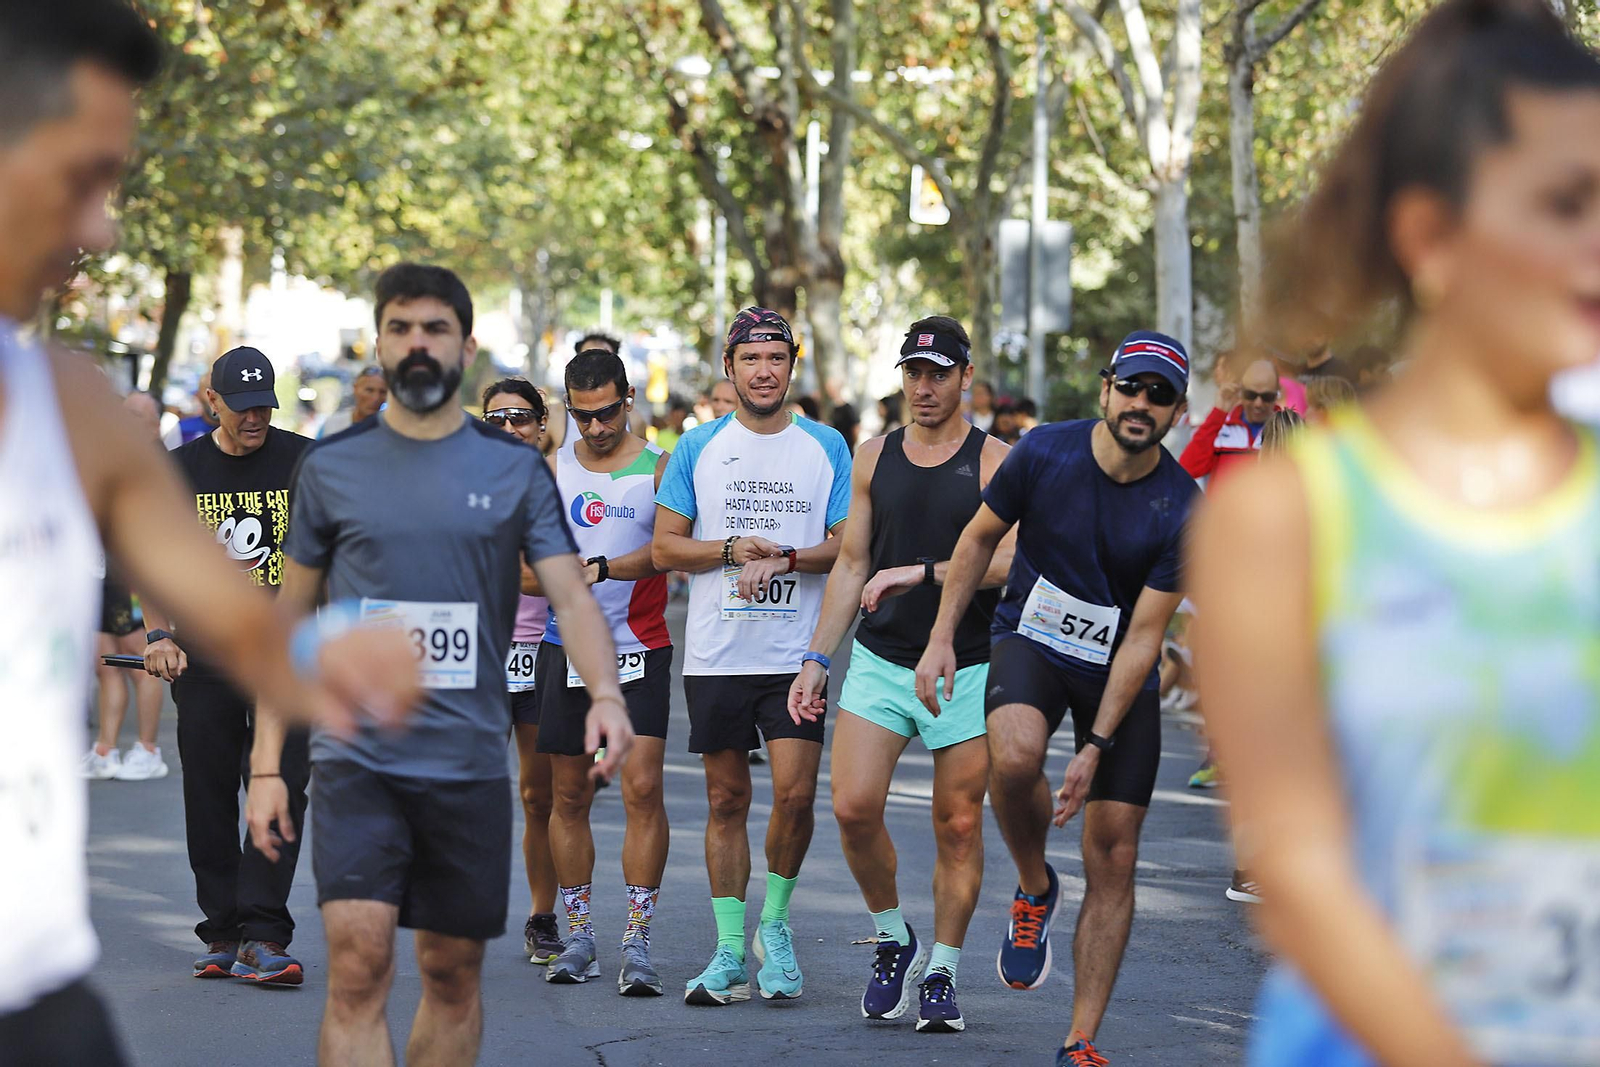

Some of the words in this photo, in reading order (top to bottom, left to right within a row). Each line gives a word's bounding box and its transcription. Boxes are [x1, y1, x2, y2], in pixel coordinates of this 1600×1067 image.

[734, 480, 747, 493] NO
[748, 481, 757, 494] SE
[759, 481, 794, 494] FRACASA
[196, 493, 235, 511] FELIX
[236, 491, 263, 509] THE
[266, 489, 289, 508] CAT
[725, 498, 751, 511] HASTA
[753, 499, 769, 514] QUE
[771, 500, 784, 512] NO
[785, 500, 794, 513] SE
[725, 516, 735, 529] DE
[1060, 613, 1110, 646] 574
[408, 627, 470, 662] 399
[508, 653, 534, 677] 49
